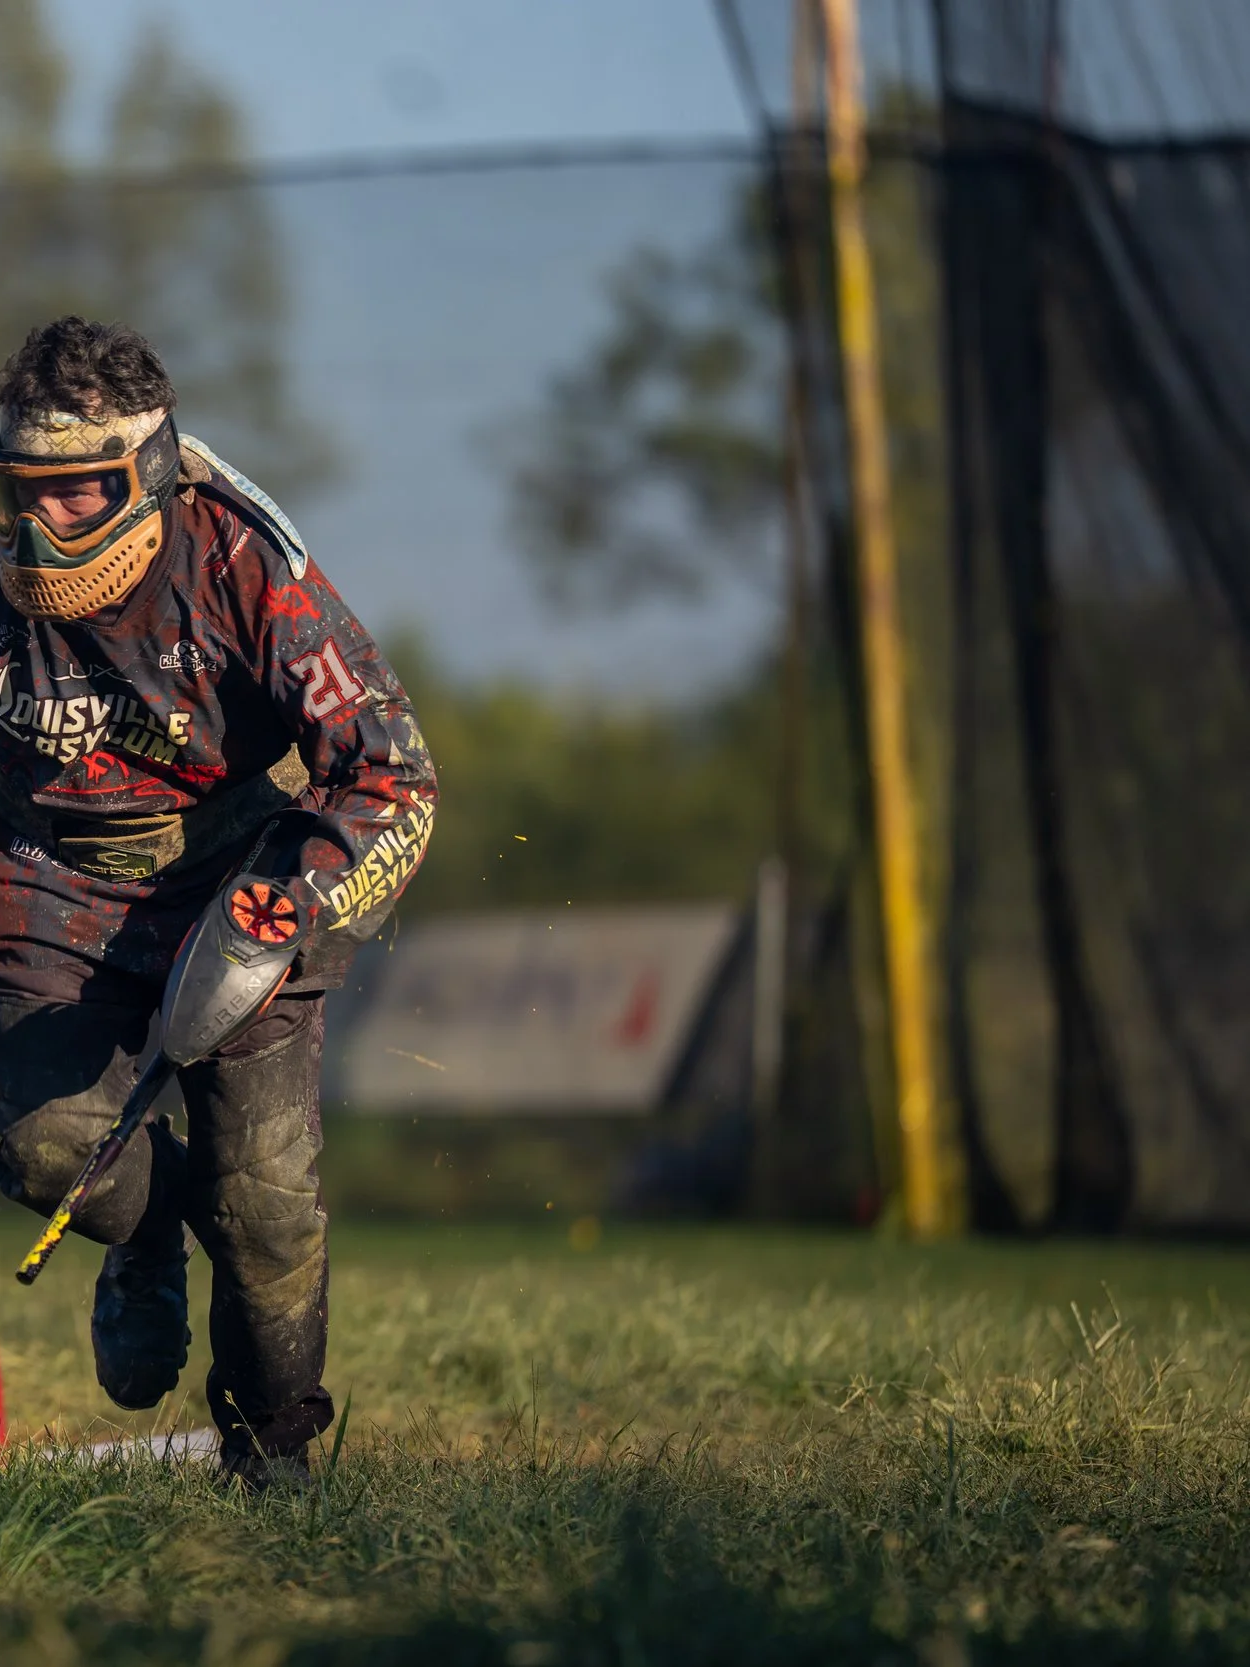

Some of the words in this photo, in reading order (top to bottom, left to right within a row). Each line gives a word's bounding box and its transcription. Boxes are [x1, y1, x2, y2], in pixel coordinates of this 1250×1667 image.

[286, 636, 366, 724] 21
[35, 727, 178, 766] ASYLUM
[79, 862, 147, 877] carbon
[198, 974, 263, 1041] CRBN
